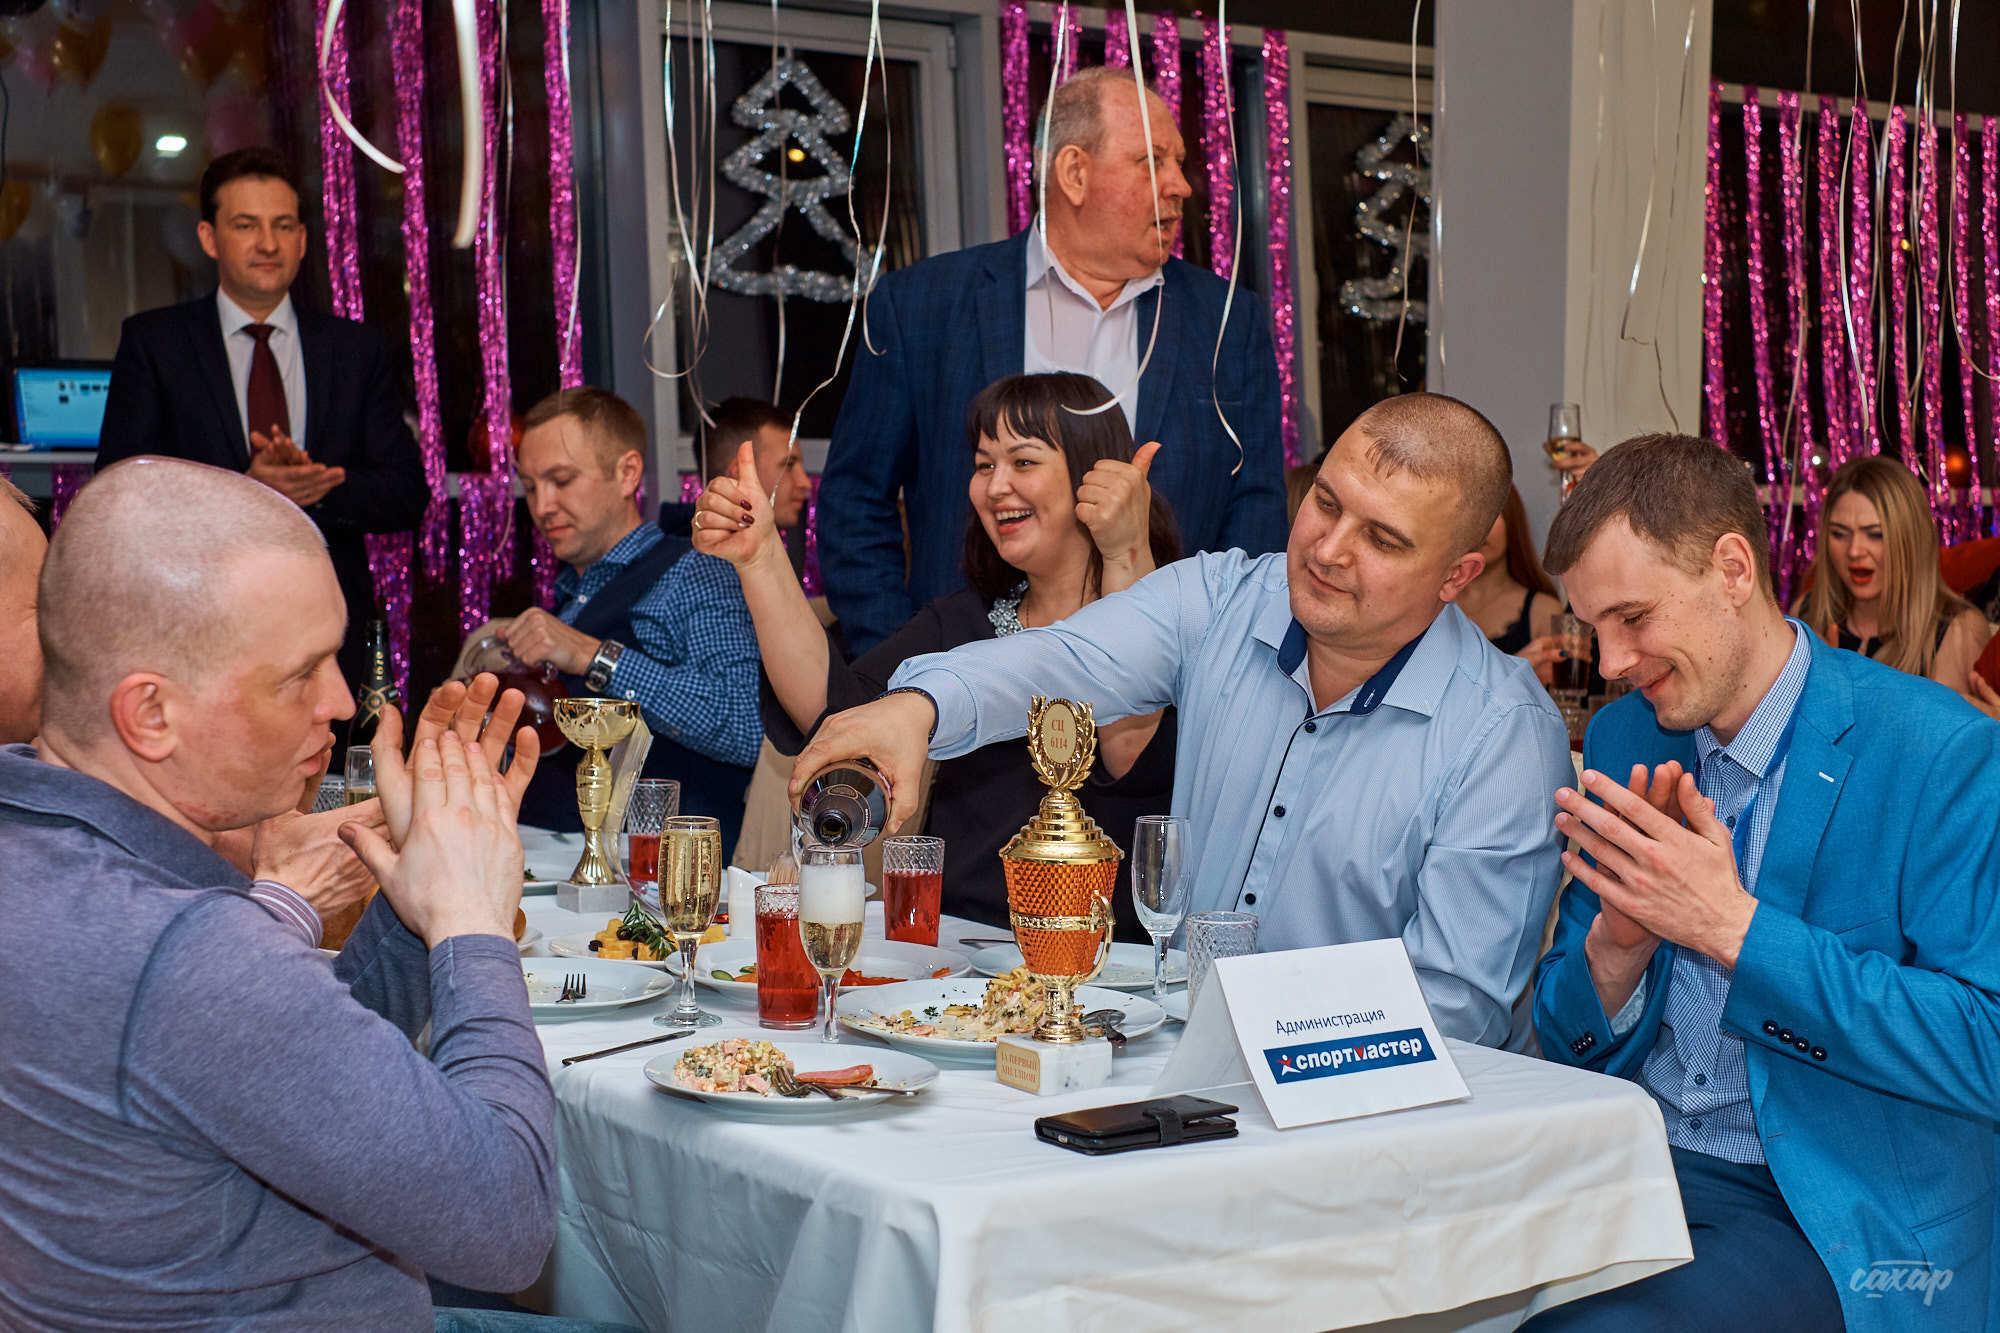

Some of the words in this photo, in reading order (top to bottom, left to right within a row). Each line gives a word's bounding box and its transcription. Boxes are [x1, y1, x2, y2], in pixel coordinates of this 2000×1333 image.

[1051, 719, 1065, 733] СЦ
[1050, 737, 1068, 749] 6114
[1275, 1009, 1386, 1036] Администрация
